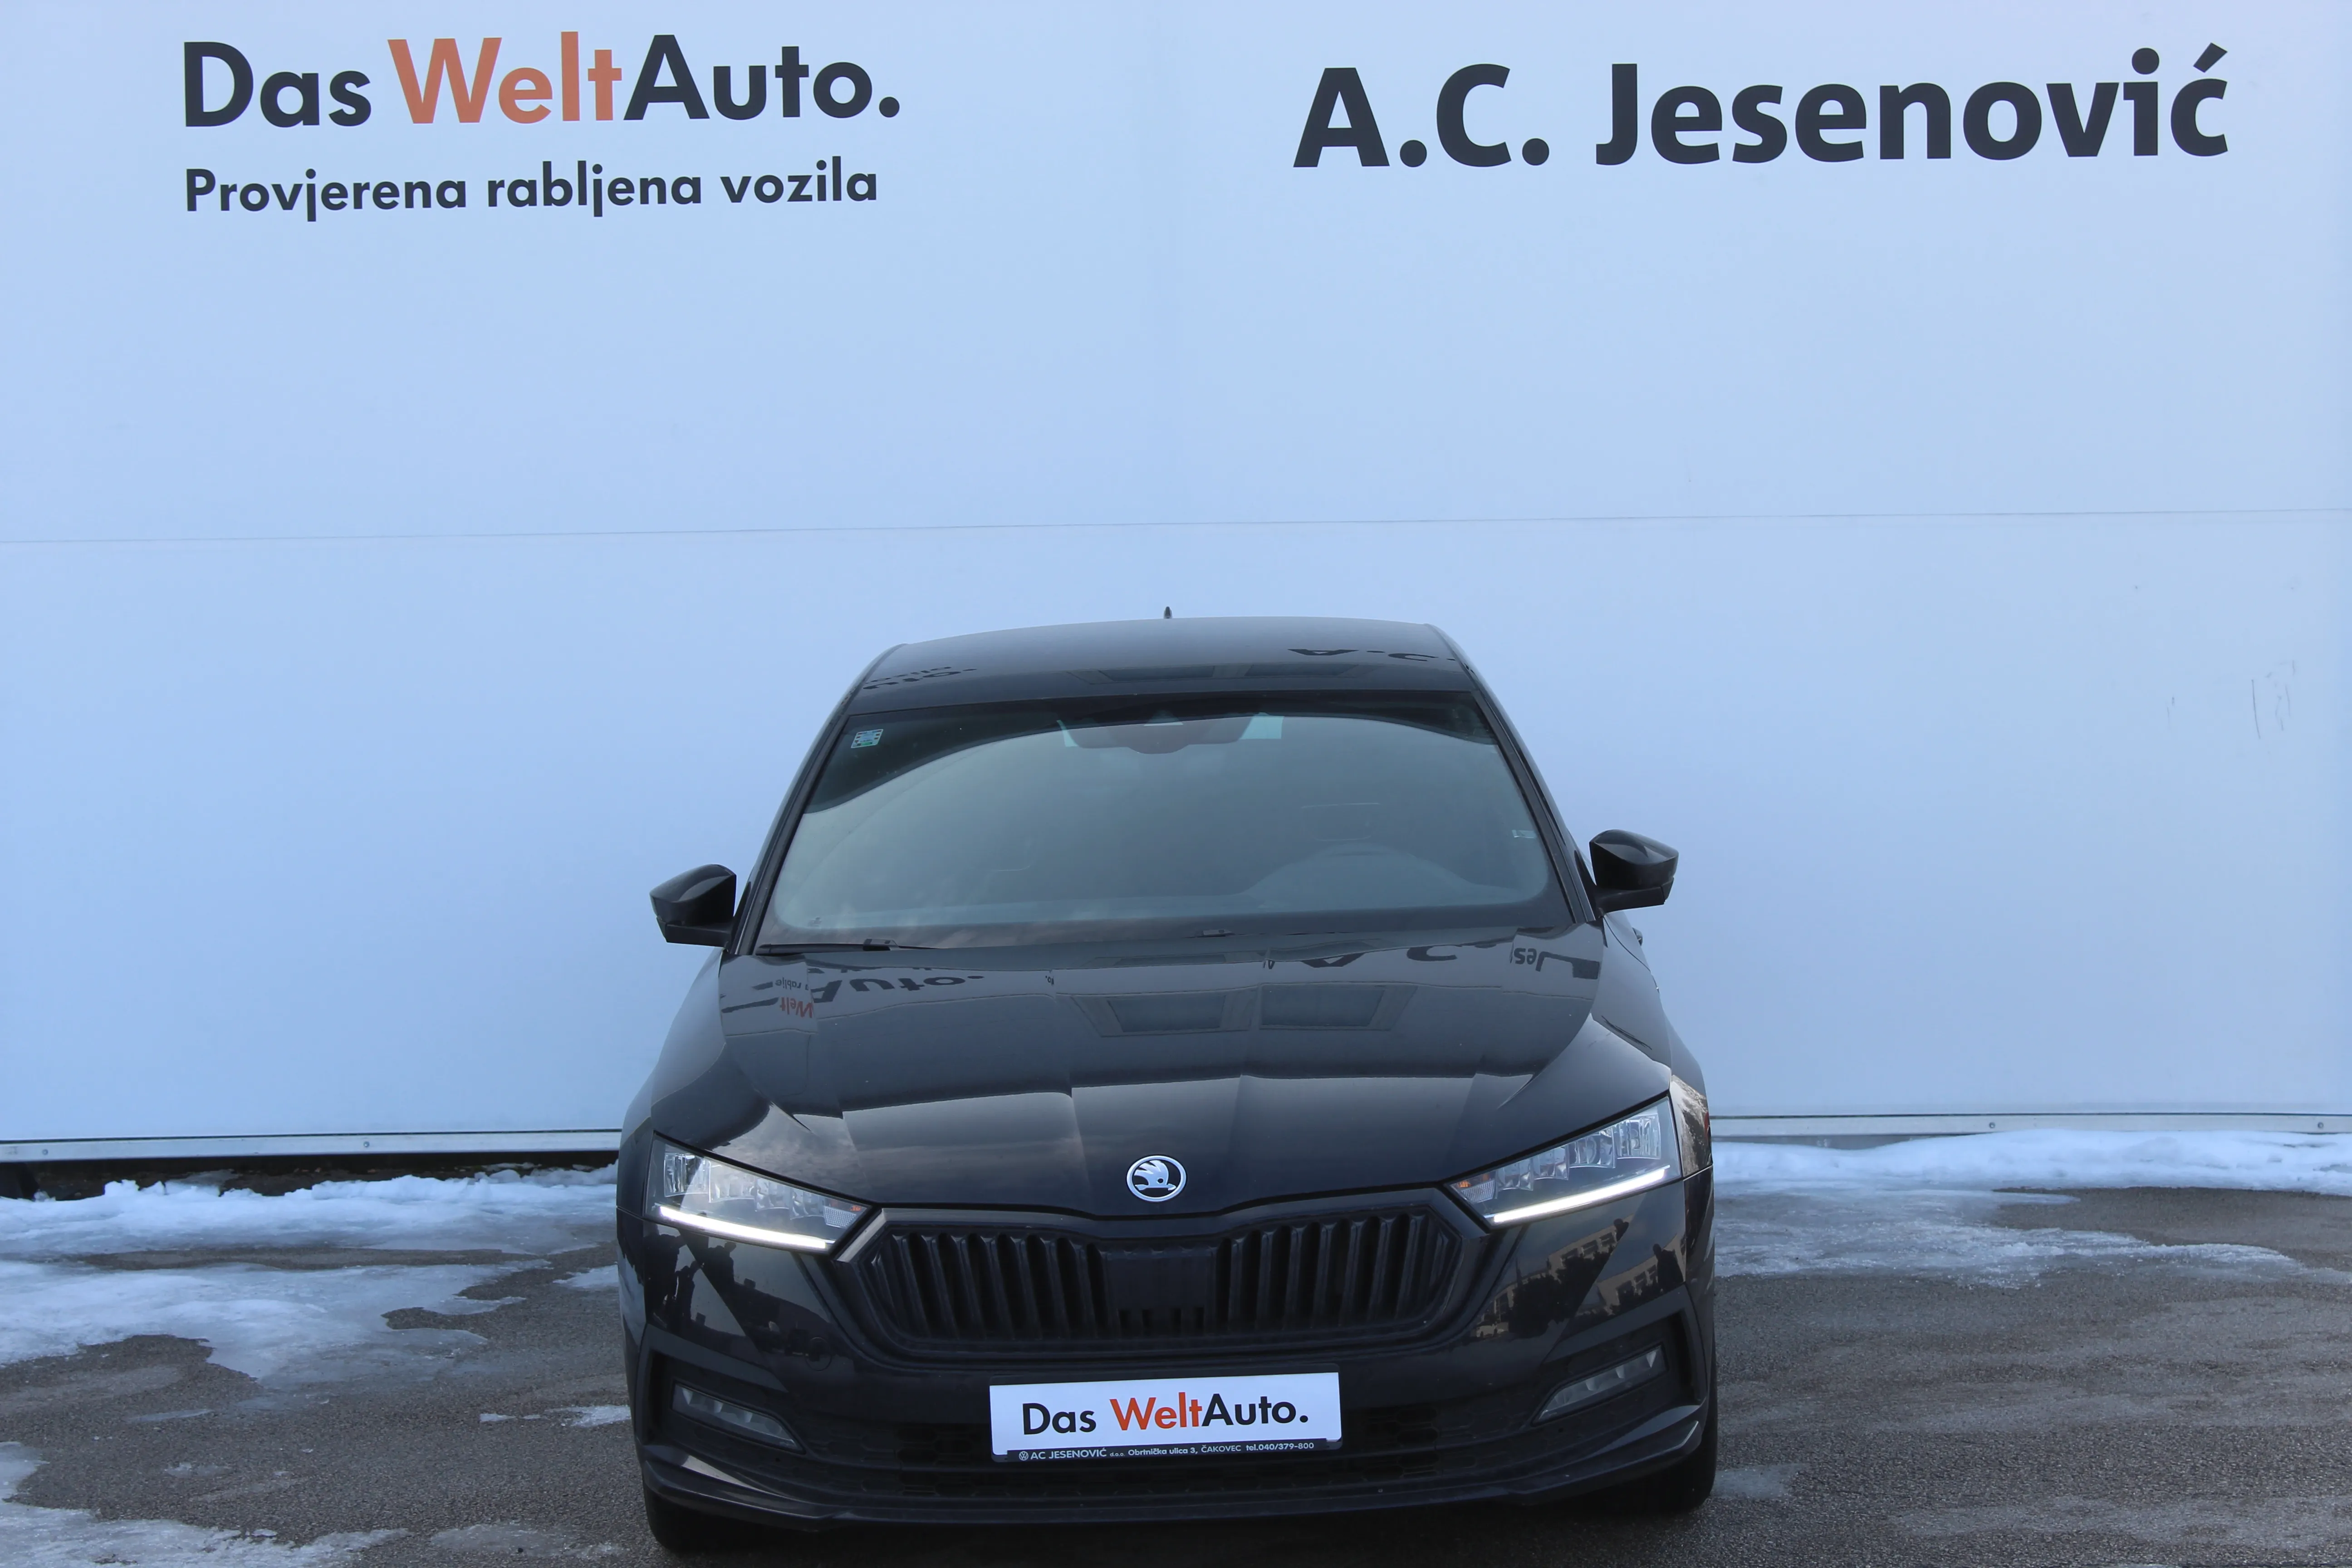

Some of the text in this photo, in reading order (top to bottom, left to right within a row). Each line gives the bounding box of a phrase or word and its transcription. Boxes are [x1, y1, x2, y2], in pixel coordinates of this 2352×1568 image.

[184, 32, 900, 127] Das WeltAuto.
[1293, 43, 2228, 168] A.C. Jesenović
[186, 156, 877, 222] Provjerena rabljena vozila
[1022, 1392, 1309, 1435] Das WeltAuto.
[1030, 1451, 1046, 1460] AC
[1049, 1447, 1107, 1460] JESENOVIĆ
[1201, 1444, 1241, 1453] ČAKOVEC
[1246, 1442, 1314, 1451] tel.040/379-800
